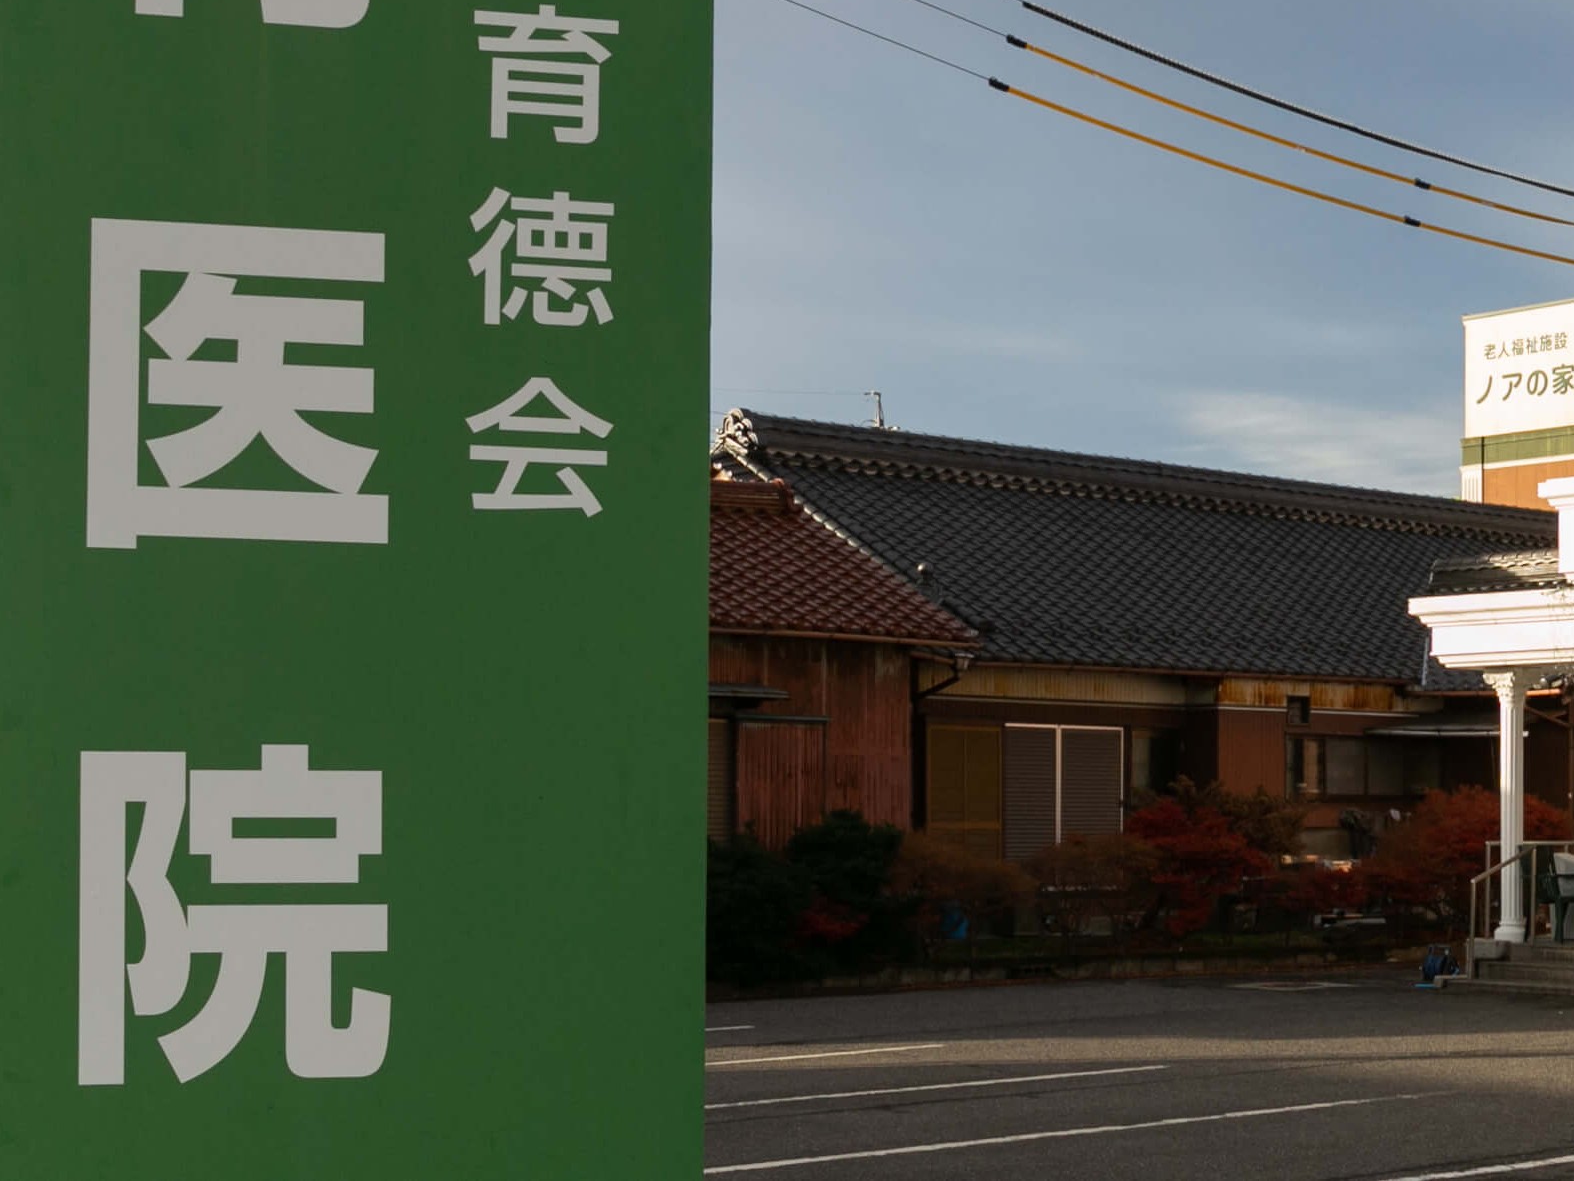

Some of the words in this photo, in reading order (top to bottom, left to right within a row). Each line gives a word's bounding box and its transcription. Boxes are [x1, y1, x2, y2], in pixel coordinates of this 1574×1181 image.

[1484, 332, 1568, 360] 老人福祉施設
